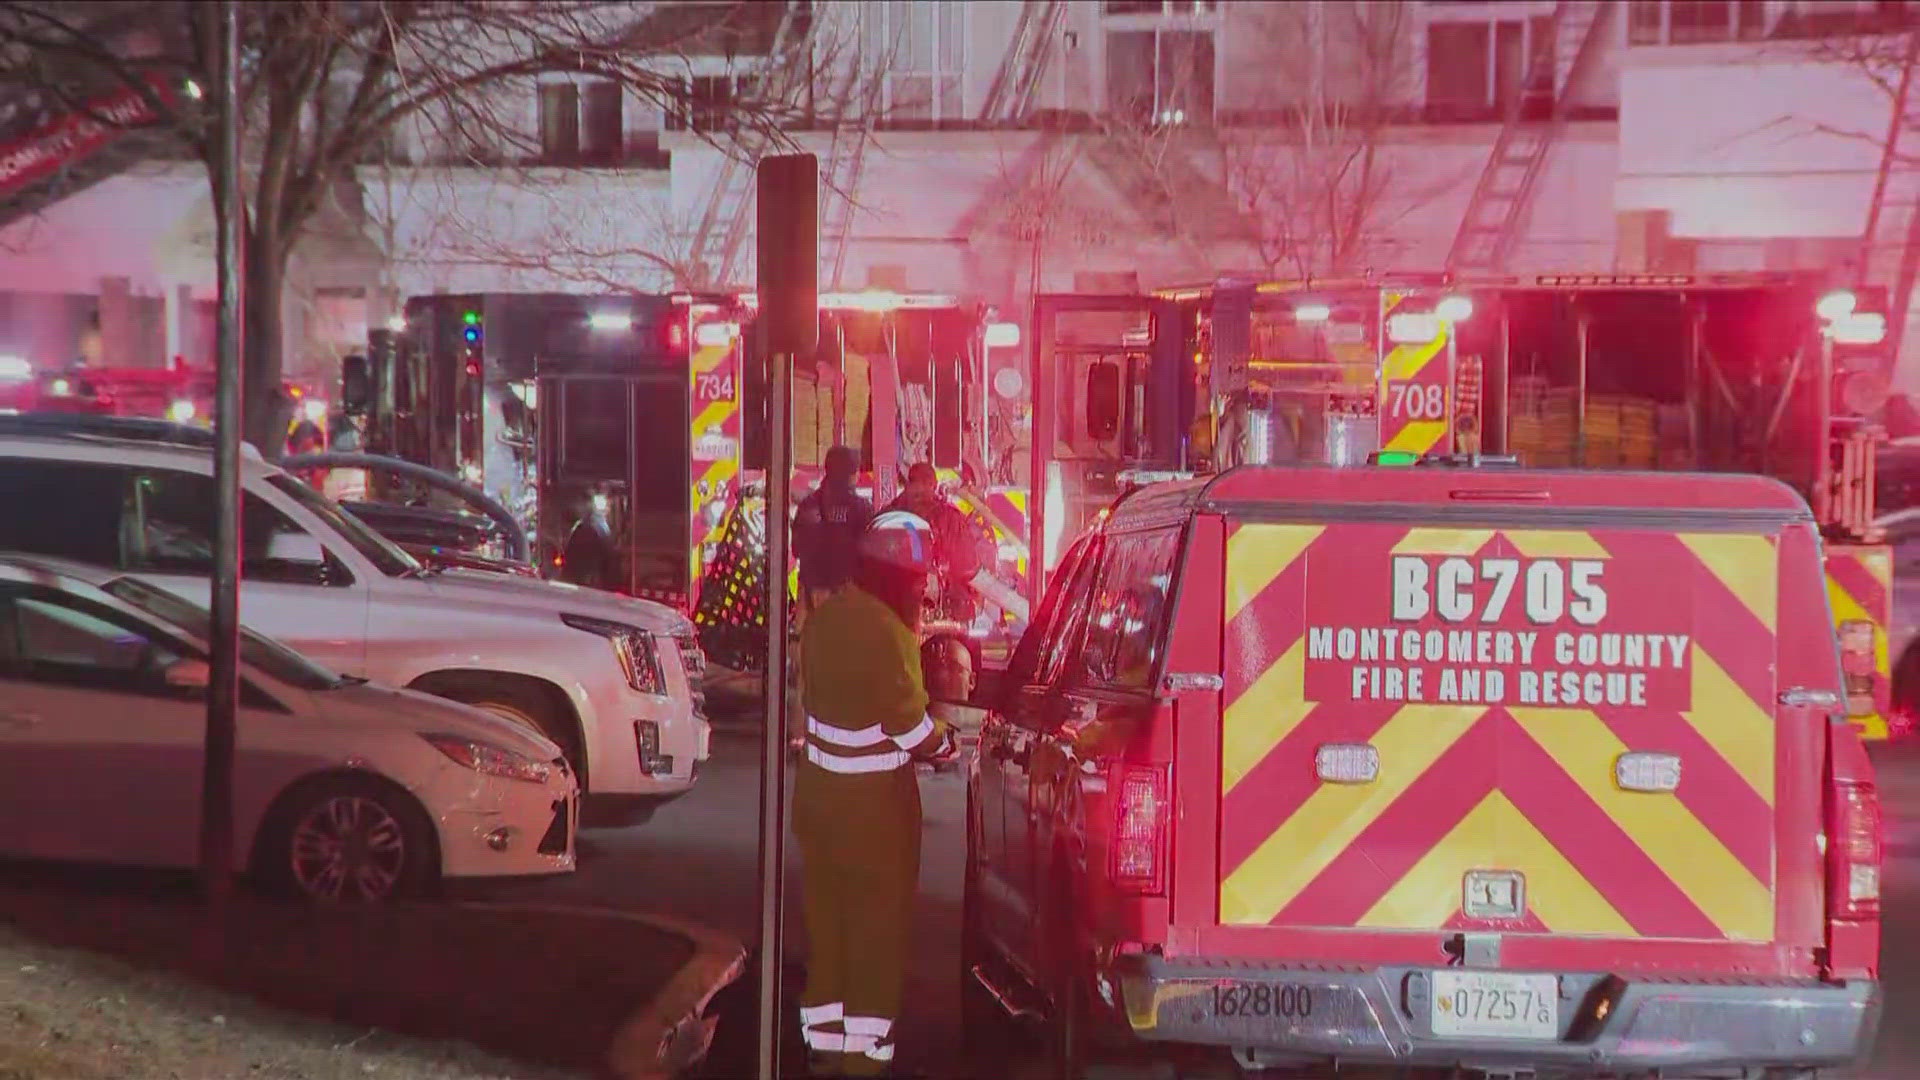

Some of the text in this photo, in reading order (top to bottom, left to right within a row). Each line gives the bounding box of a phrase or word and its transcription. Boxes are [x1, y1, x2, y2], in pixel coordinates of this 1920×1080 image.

[697, 374, 734, 400] 734
[1389, 384, 1443, 419] 708
[1391, 556, 1608, 625] BC705
[1308, 627, 1690, 669] MONTGOMERY COUNTY
[1351, 667, 1648, 707] FIRE AND RESCUE
[1212, 985, 1312, 1018] 1628100
[1455, 988, 1534, 1022] 07257
